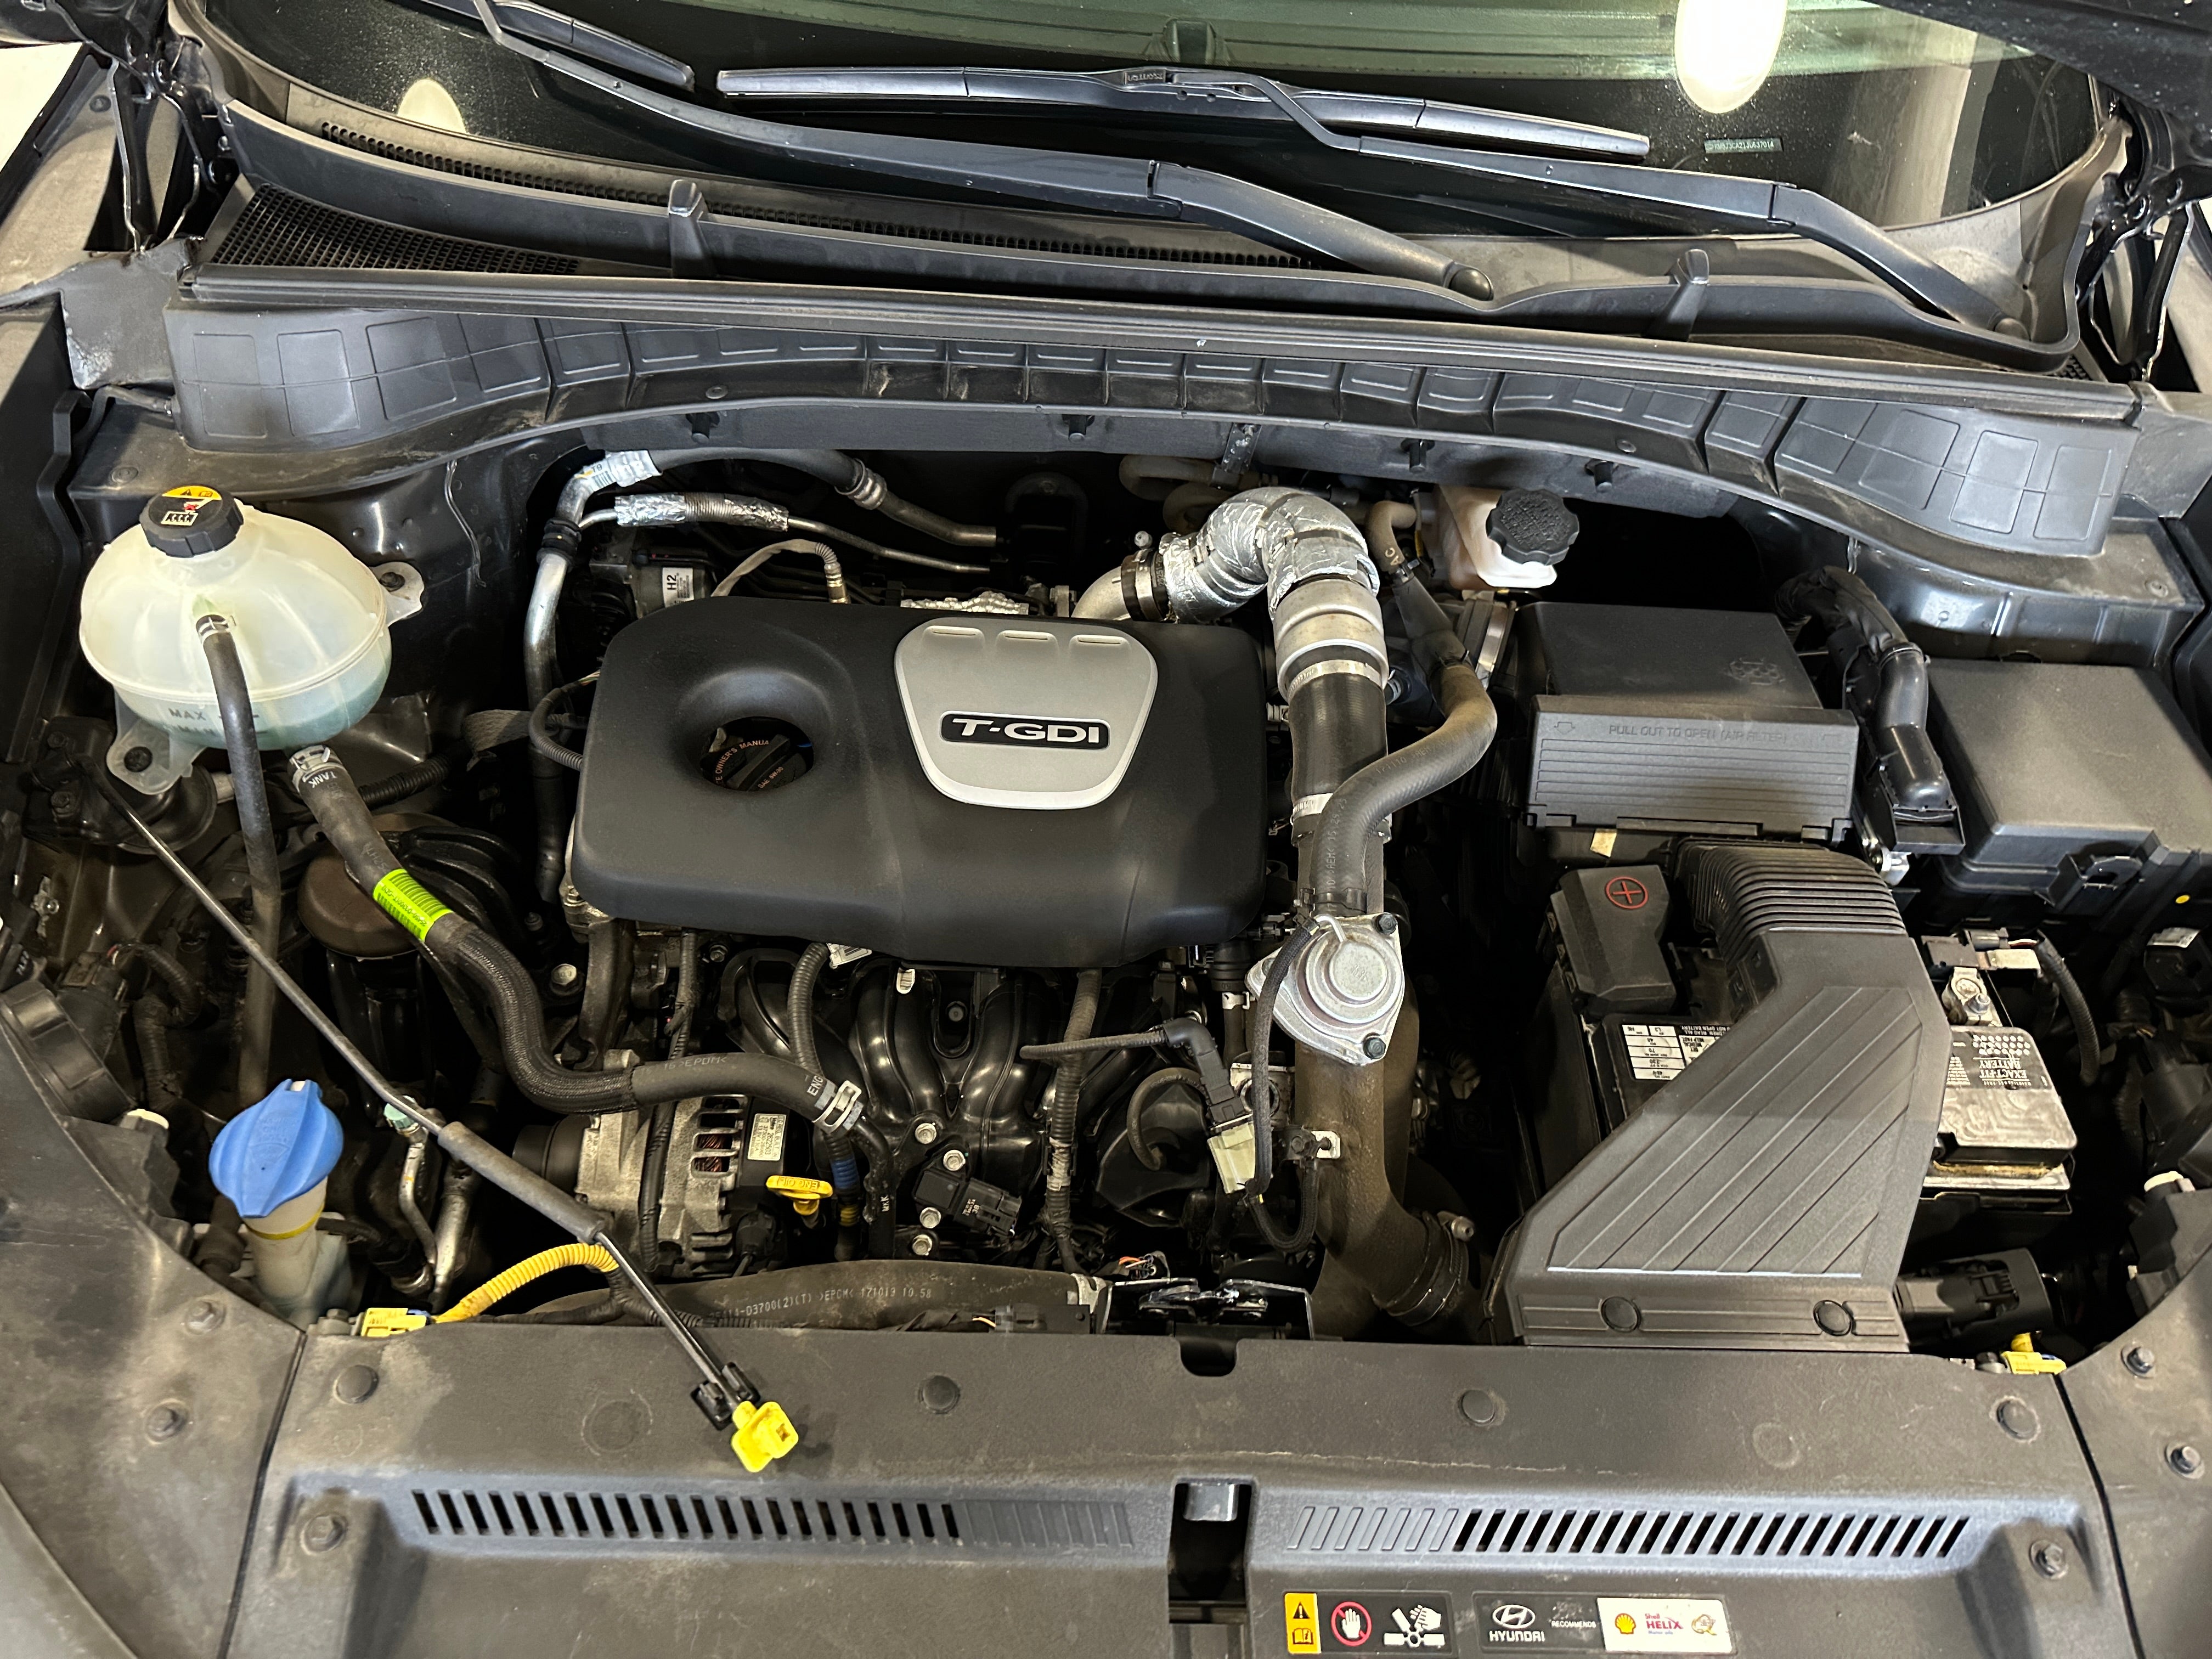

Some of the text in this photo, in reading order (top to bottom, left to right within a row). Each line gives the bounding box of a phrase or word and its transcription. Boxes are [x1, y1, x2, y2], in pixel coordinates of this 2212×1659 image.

[1385, 548, 1402, 566] AC
[667, 575, 676, 590] H2
[168, 708, 207, 721] MAX
[952, 718, 1100, 744] T-GDI
[1609, 725, 1638, 736] PULL
[1640, 726, 1664, 737] OUT
[1667, 727, 1681, 737] TO
[1684, 727, 1716, 740] OPEN
[715, 747, 738, 774] OWNER'S
[739, 740, 769, 749] MANUA
[308, 771, 337, 788] TANK
[1979, 1059, 2021, 1069] BATTERY
[806, 1075, 823, 1096] ENG
[901, 1287, 932, 1299] 10.58
[1550, 1620, 1597, 1628] RECOMMENDS
[1646, 1618, 1684, 1629] HELIX
[1489, 1630, 1545, 1643] HYUNDAI
